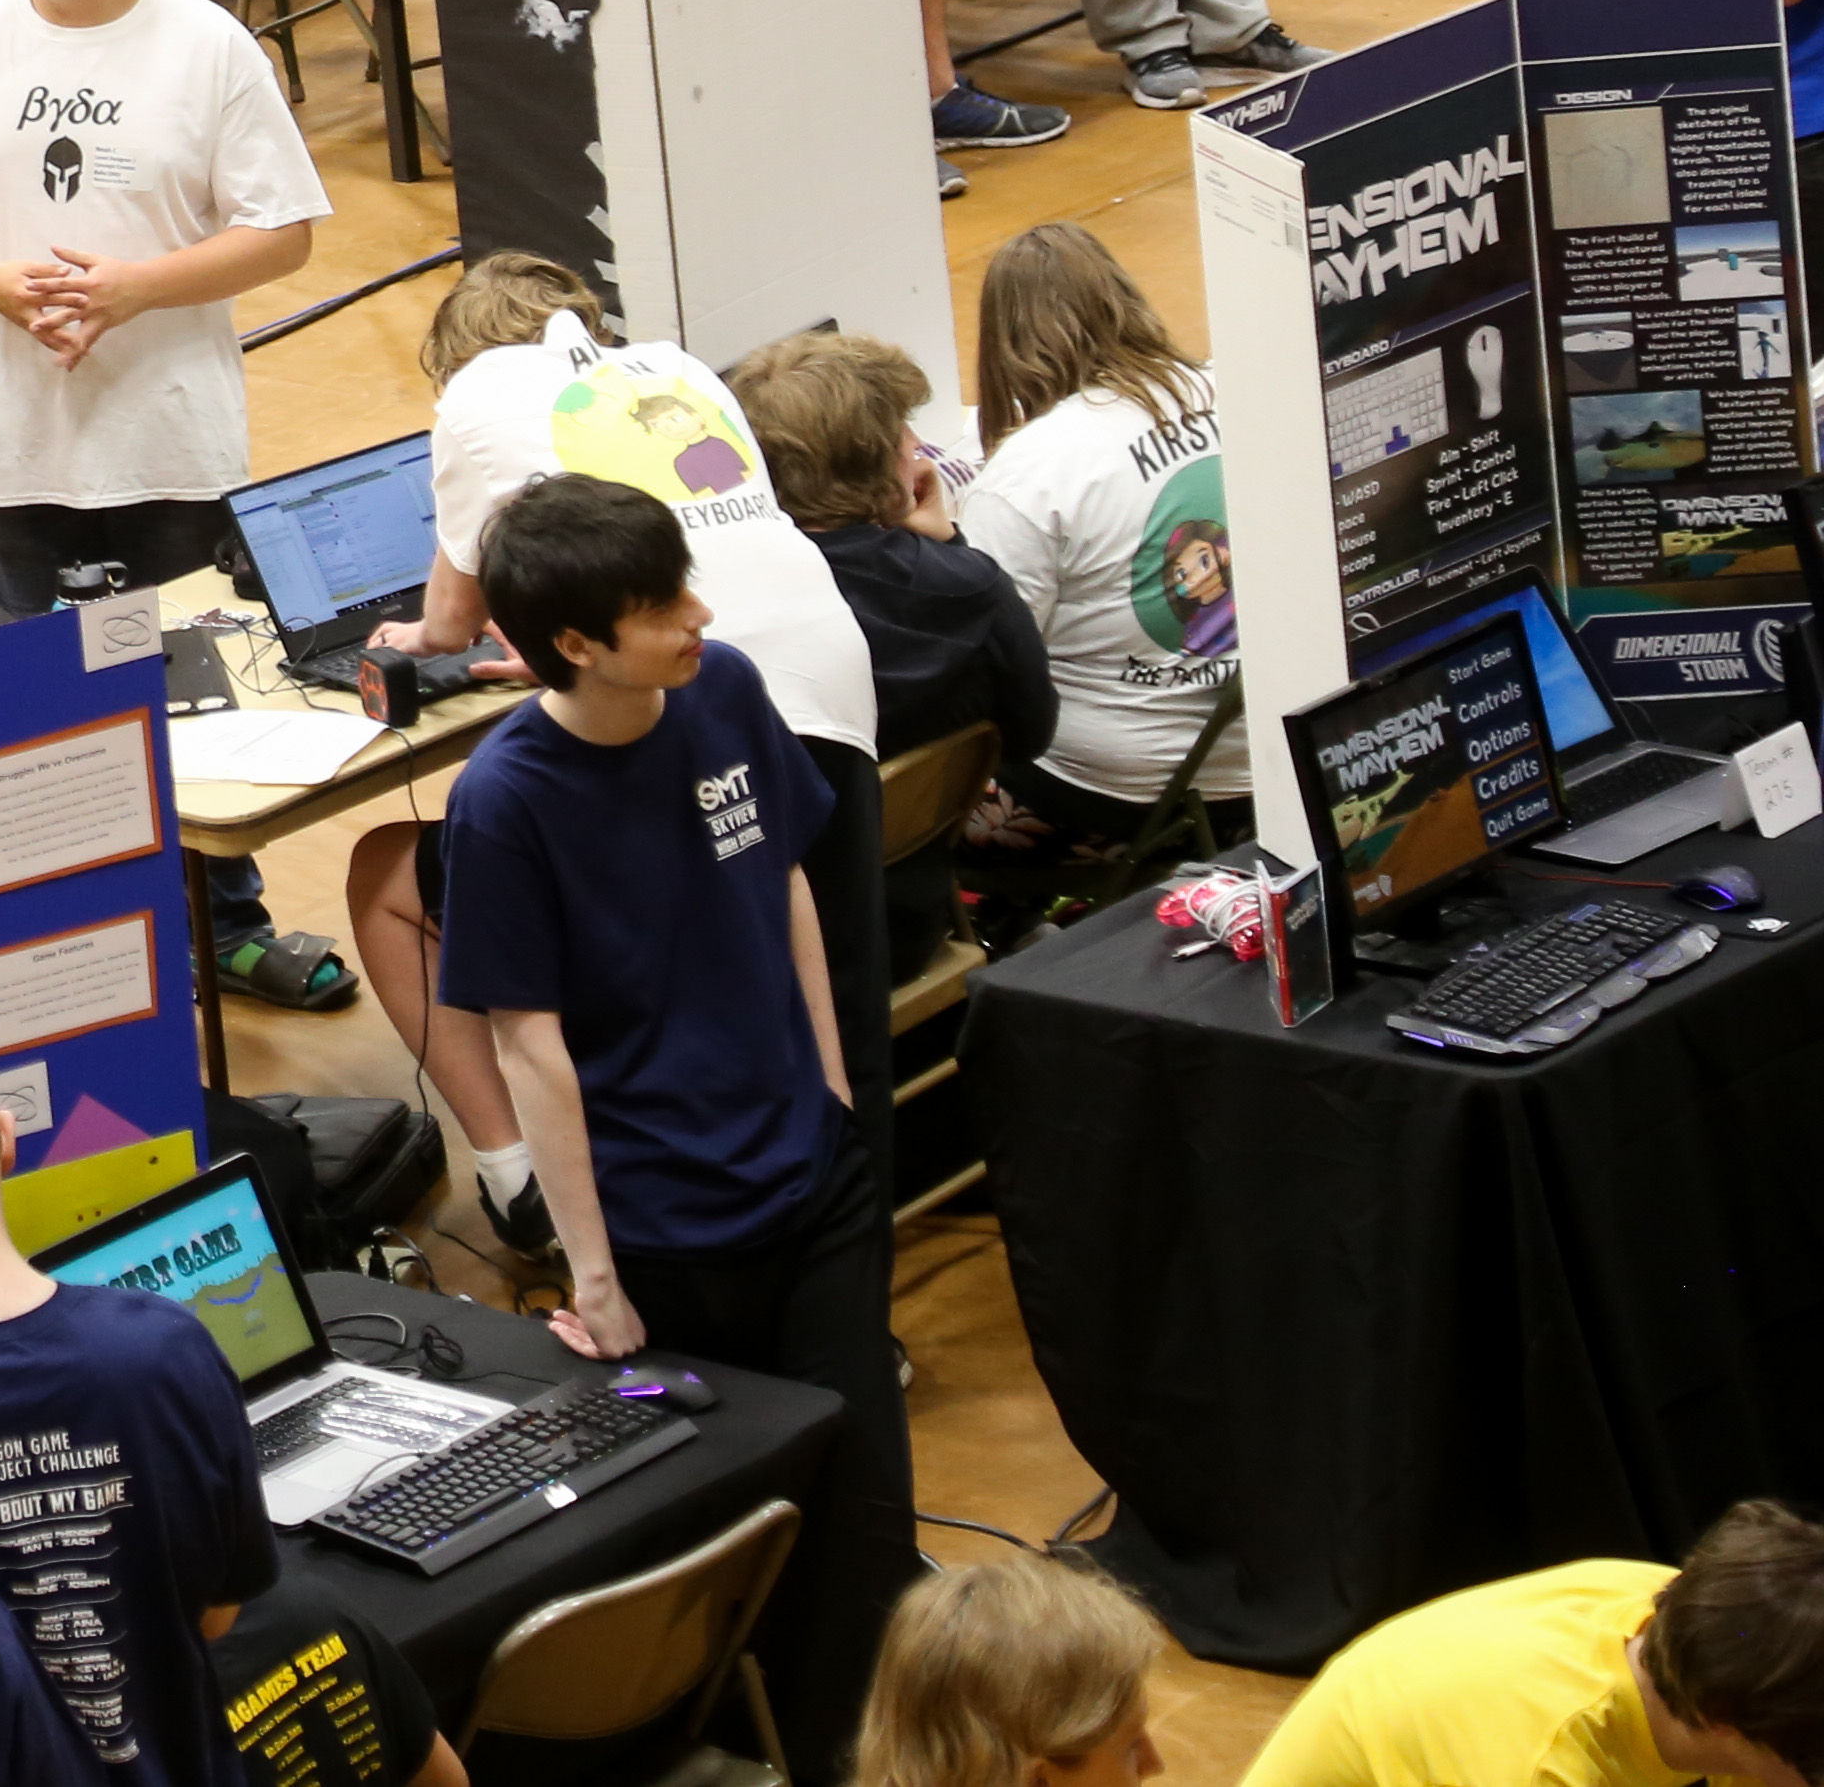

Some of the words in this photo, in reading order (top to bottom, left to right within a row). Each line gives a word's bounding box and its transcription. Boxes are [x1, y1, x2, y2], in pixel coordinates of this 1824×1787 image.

[1556, 88, 1632, 105] DESIGN
[1309, 134, 1526, 250] ENSIONAL
[1439, 448, 1460, 466] Aim
[1470, 429, 1500, 453] Shift
[1426, 470, 1462, 496] Sprint
[1473, 445, 1516, 472] Control
[1342, 481, 1381, 508] WASD
[1427, 495, 1451, 515] Fire
[1462, 480, 1490, 502] Left
[1491, 468, 1520, 487] Click
[1661, 494, 1782, 511] DIMENSION
[1437, 500, 1494, 534] Inventory
[1678, 506, 1788, 526] MAYHEM
[1615, 631, 1742, 659] DIMENSIONAL
[1449, 655, 1480, 685] Start
[1480, 645, 1512, 674] Game
[1678, 657, 1750, 683] STORM
[1457, 680, 1523, 725] Controls
[1318, 694, 1451, 771] DIMENSIONAL
[1468, 719, 1531, 762] Options
[65, 748, 106, 764] Overcome
[1338, 722, 1445, 791] MAYHEM
[697, 764, 750, 811] SMT
[1477, 755, 1541, 801] Credits
[711, 803, 758, 837] SKYVIEW
[1486, 809, 1514, 838] Quit
[1517, 795, 1550, 822] Game
[32, 951, 56, 964] Game
[59, 941, 94, 958] Features
[173, 1223, 243, 1277] GAME
[29, 1432, 71, 1455] GAME
[40, 1445, 121, 1474] CHALLENGE
[51, 1489, 77, 1513] MY
[83, 1482, 126, 1511] GAME
[226, 1666, 298, 1733] AGAMES
[296, 1633, 348, 1678] TEAM
